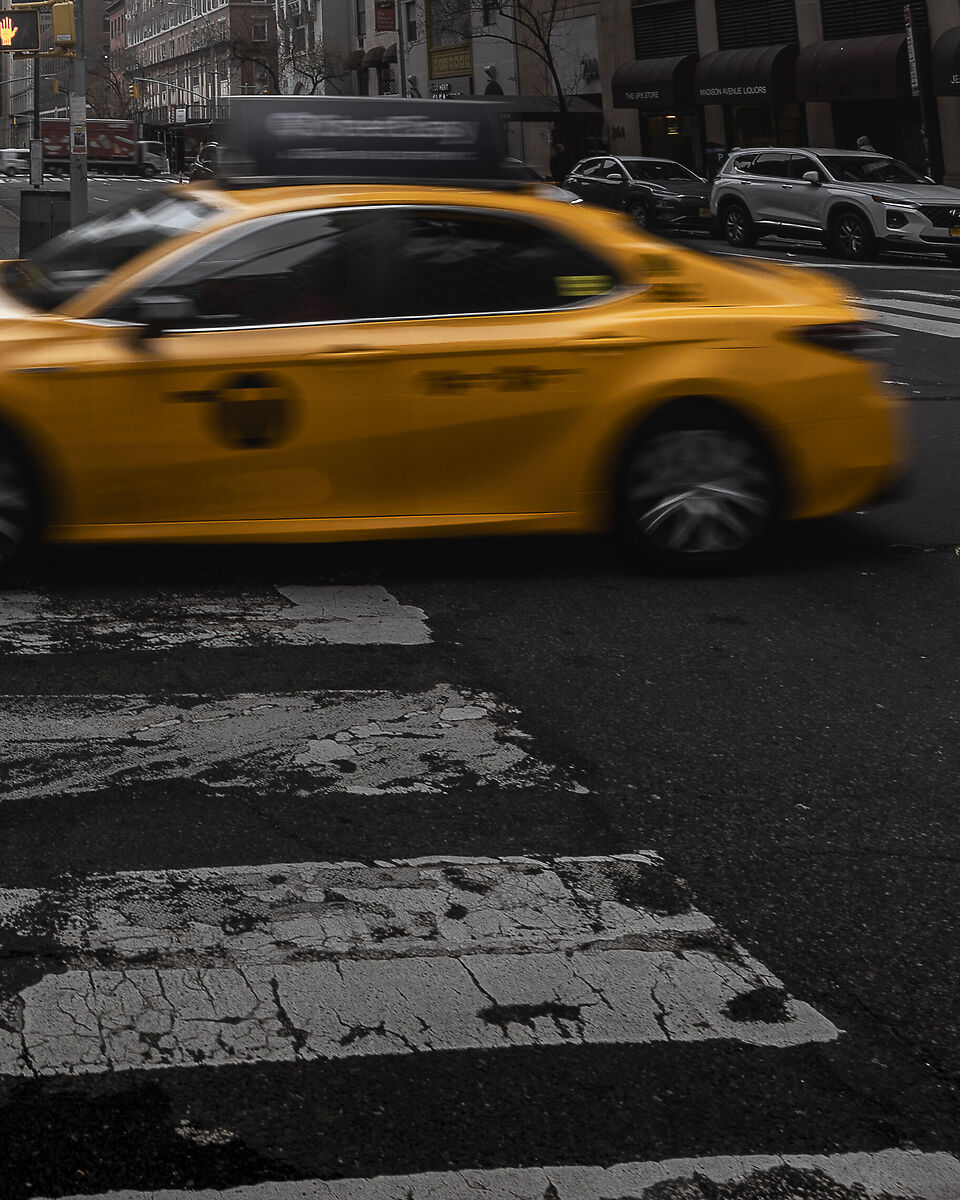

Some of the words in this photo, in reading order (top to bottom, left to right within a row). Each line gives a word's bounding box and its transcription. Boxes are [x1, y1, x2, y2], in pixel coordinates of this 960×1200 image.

[699, 88, 722, 96] MADISON
[722, 87, 742, 95] AVENUE
[743, 86, 767, 95] LIQUORS
